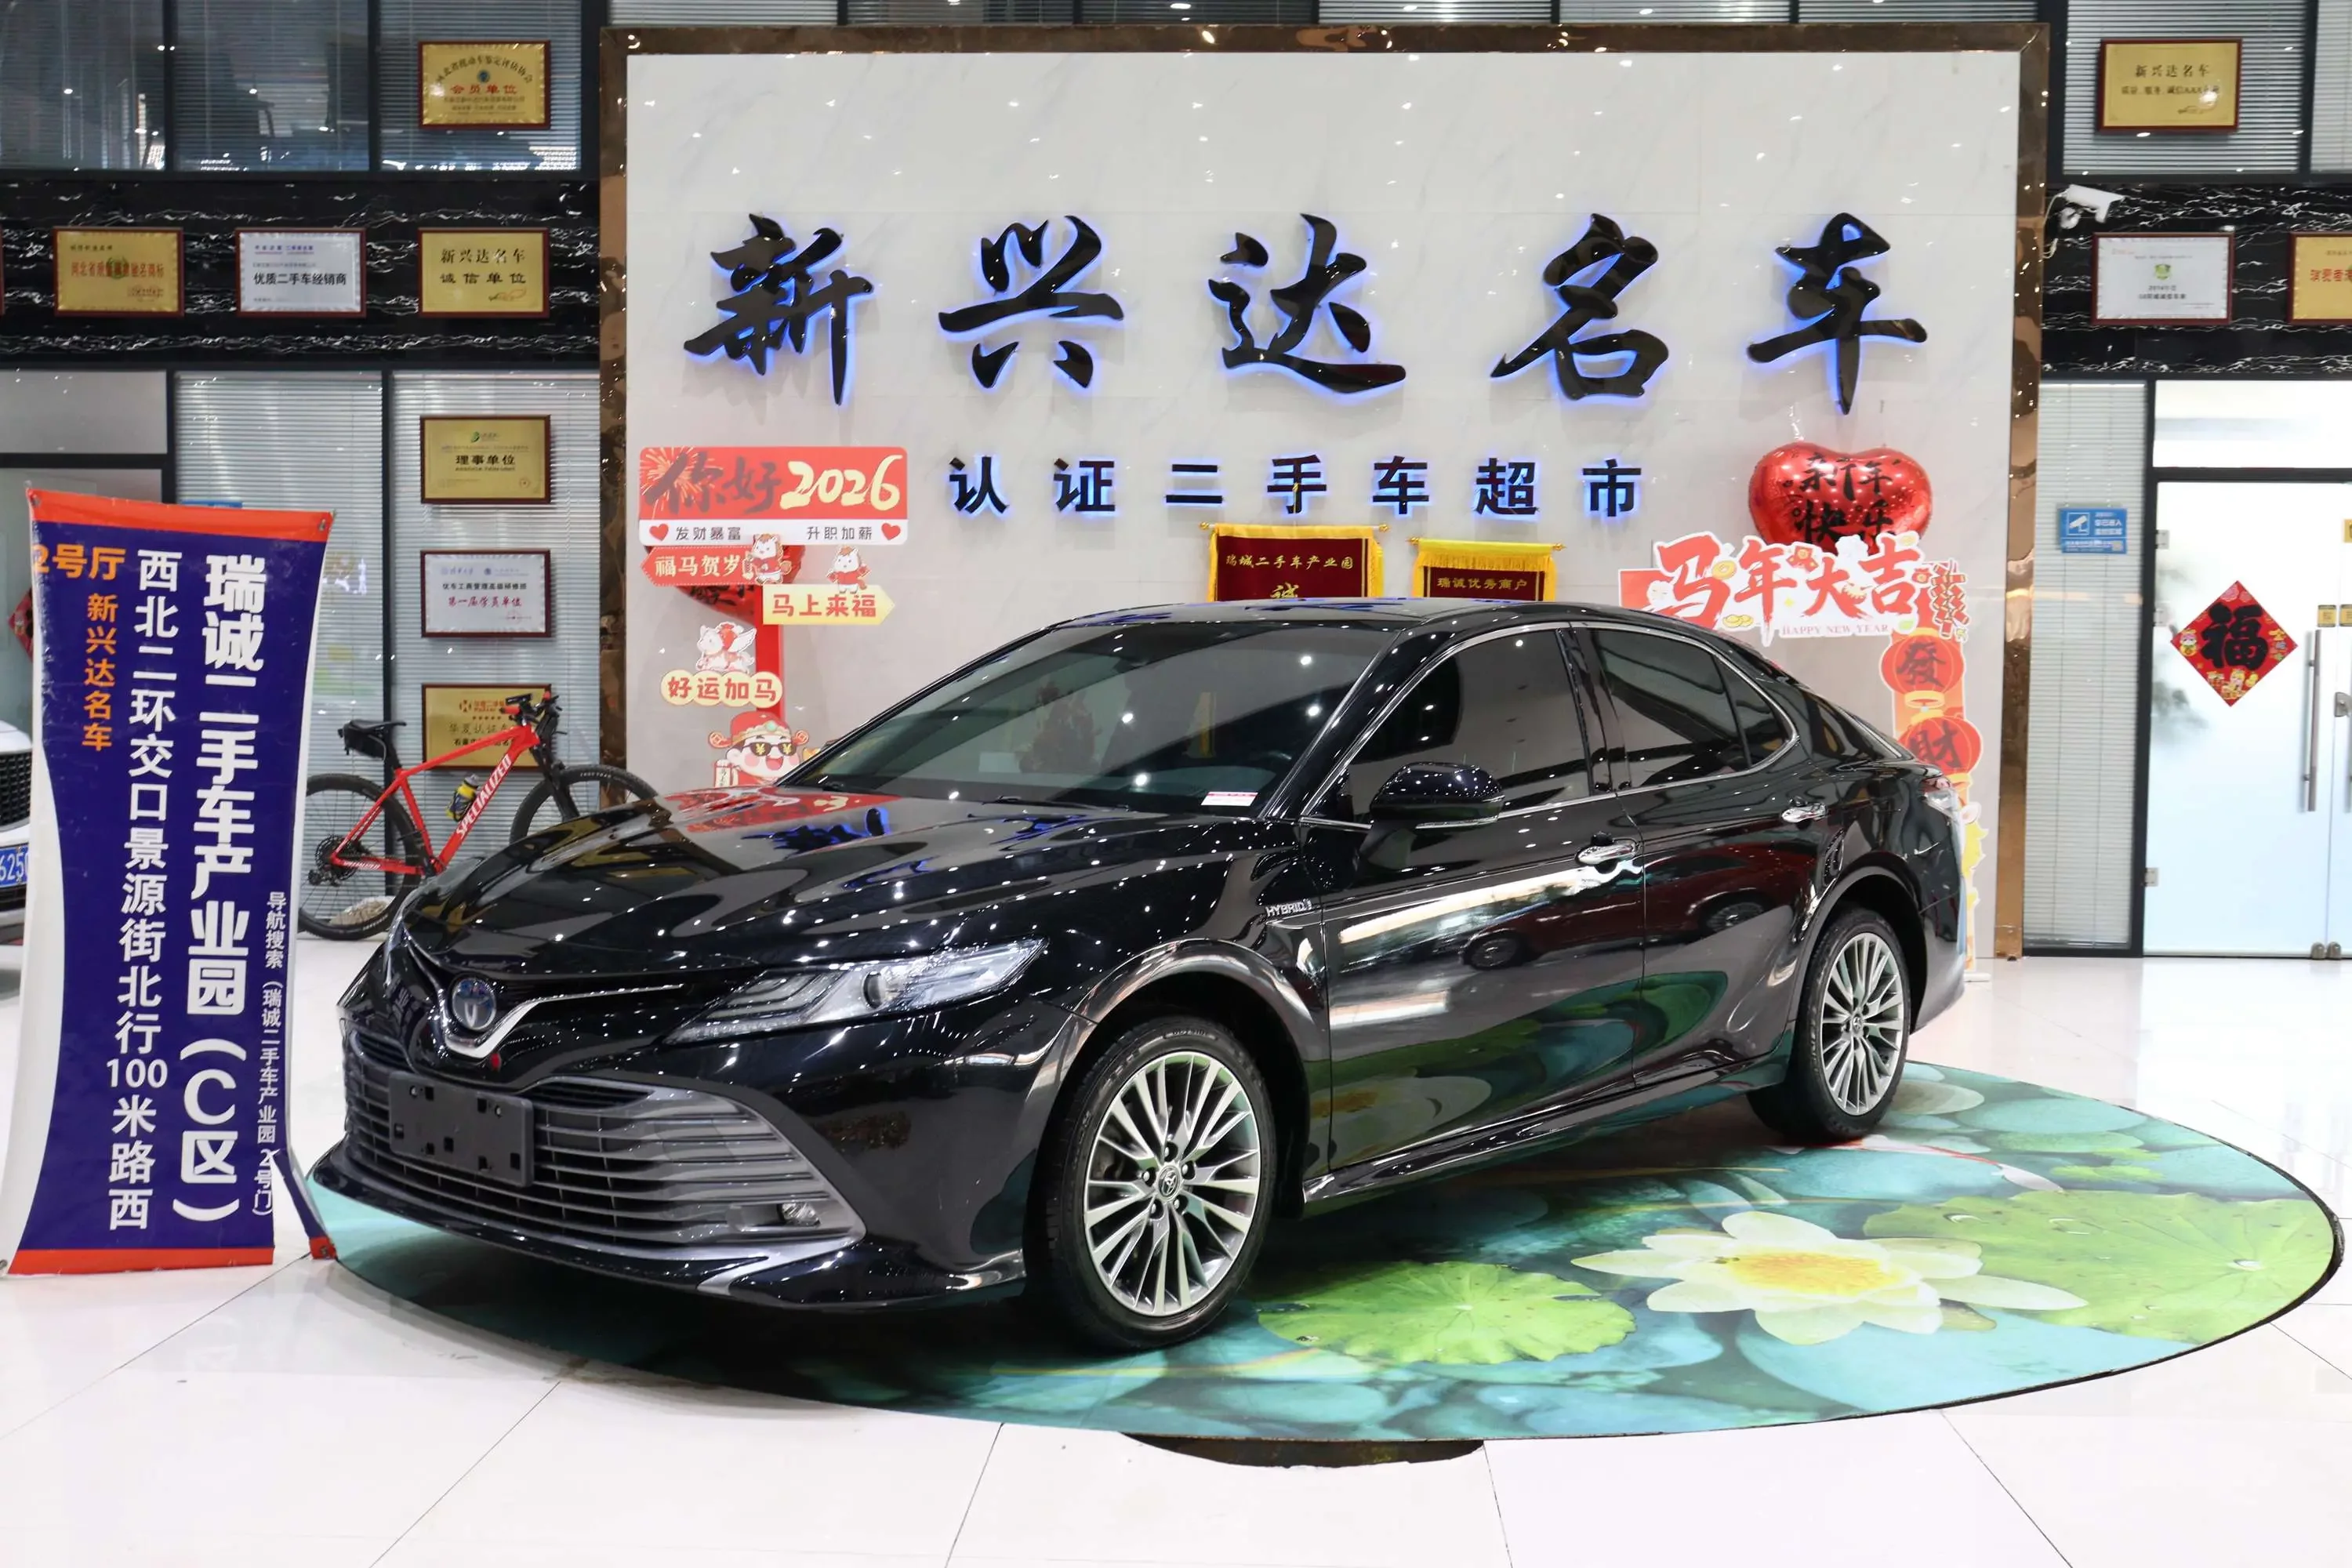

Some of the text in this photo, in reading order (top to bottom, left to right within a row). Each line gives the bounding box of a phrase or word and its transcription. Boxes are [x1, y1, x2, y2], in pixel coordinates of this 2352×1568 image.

[2136, 64, 2210, 78] 新兴达名车
[450, 84, 517, 95] 会员单位
[441, 248, 525, 264] 新兴达名车
[253, 272, 347, 285] 优质二手车经销商
[440, 272, 526, 285] 诚信单位
[684, 212, 1929, 416] 新兴达名车
[456, 454, 516, 466] 理事单位
[644, 450, 904, 516] 你好 2026
[949, 453, 1642, 517] 认证二手车超市
[675, 525, 873, 542] 发财暴富 升职加薪
[33, 544, 126, 579] 2号厅
[655, 554, 741, 577] 福马贺岁
[1436, 577, 1528, 590] 瑞诚优秀商户
[1656, 534, 1922, 632] 马年大吉
[771, 593, 877, 618] 马上来福
[1782, 624, 1889, 635] HAPPY NEW YEAR
[2200, 601, 2269, 671] 福
[82, 593, 119, 752] 新兴达名车
[667, 677, 777, 701] 好运加马
[456, 753, 513, 840] SPECIALIZED
[0, 853, 28, 880] 625
[106, 549, 183, 1231] 西北二环交口景源街北行100米路西
[1265, 902, 1305, 917] HYBRID
[265, 891, 288, 969] 导航搜索
